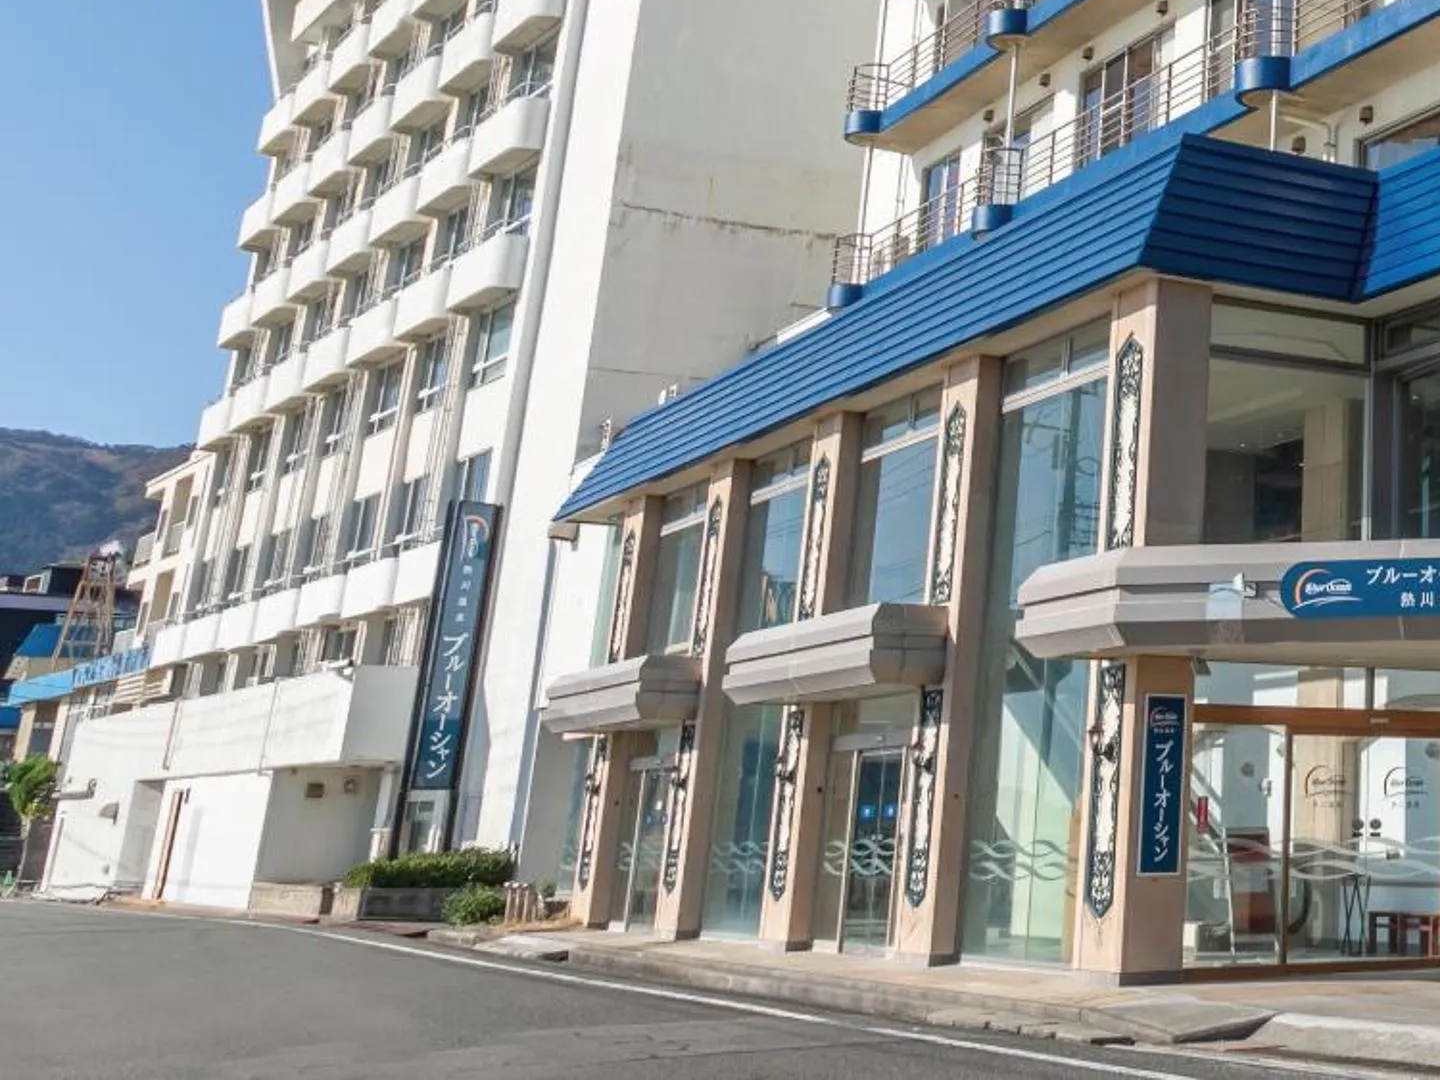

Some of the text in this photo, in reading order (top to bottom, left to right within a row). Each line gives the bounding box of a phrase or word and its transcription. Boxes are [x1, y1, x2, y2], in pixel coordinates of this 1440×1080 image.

[426, 632, 469, 779] ブルーオーシャン
[1153, 740, 1174, 863] ブルーオーシャン
